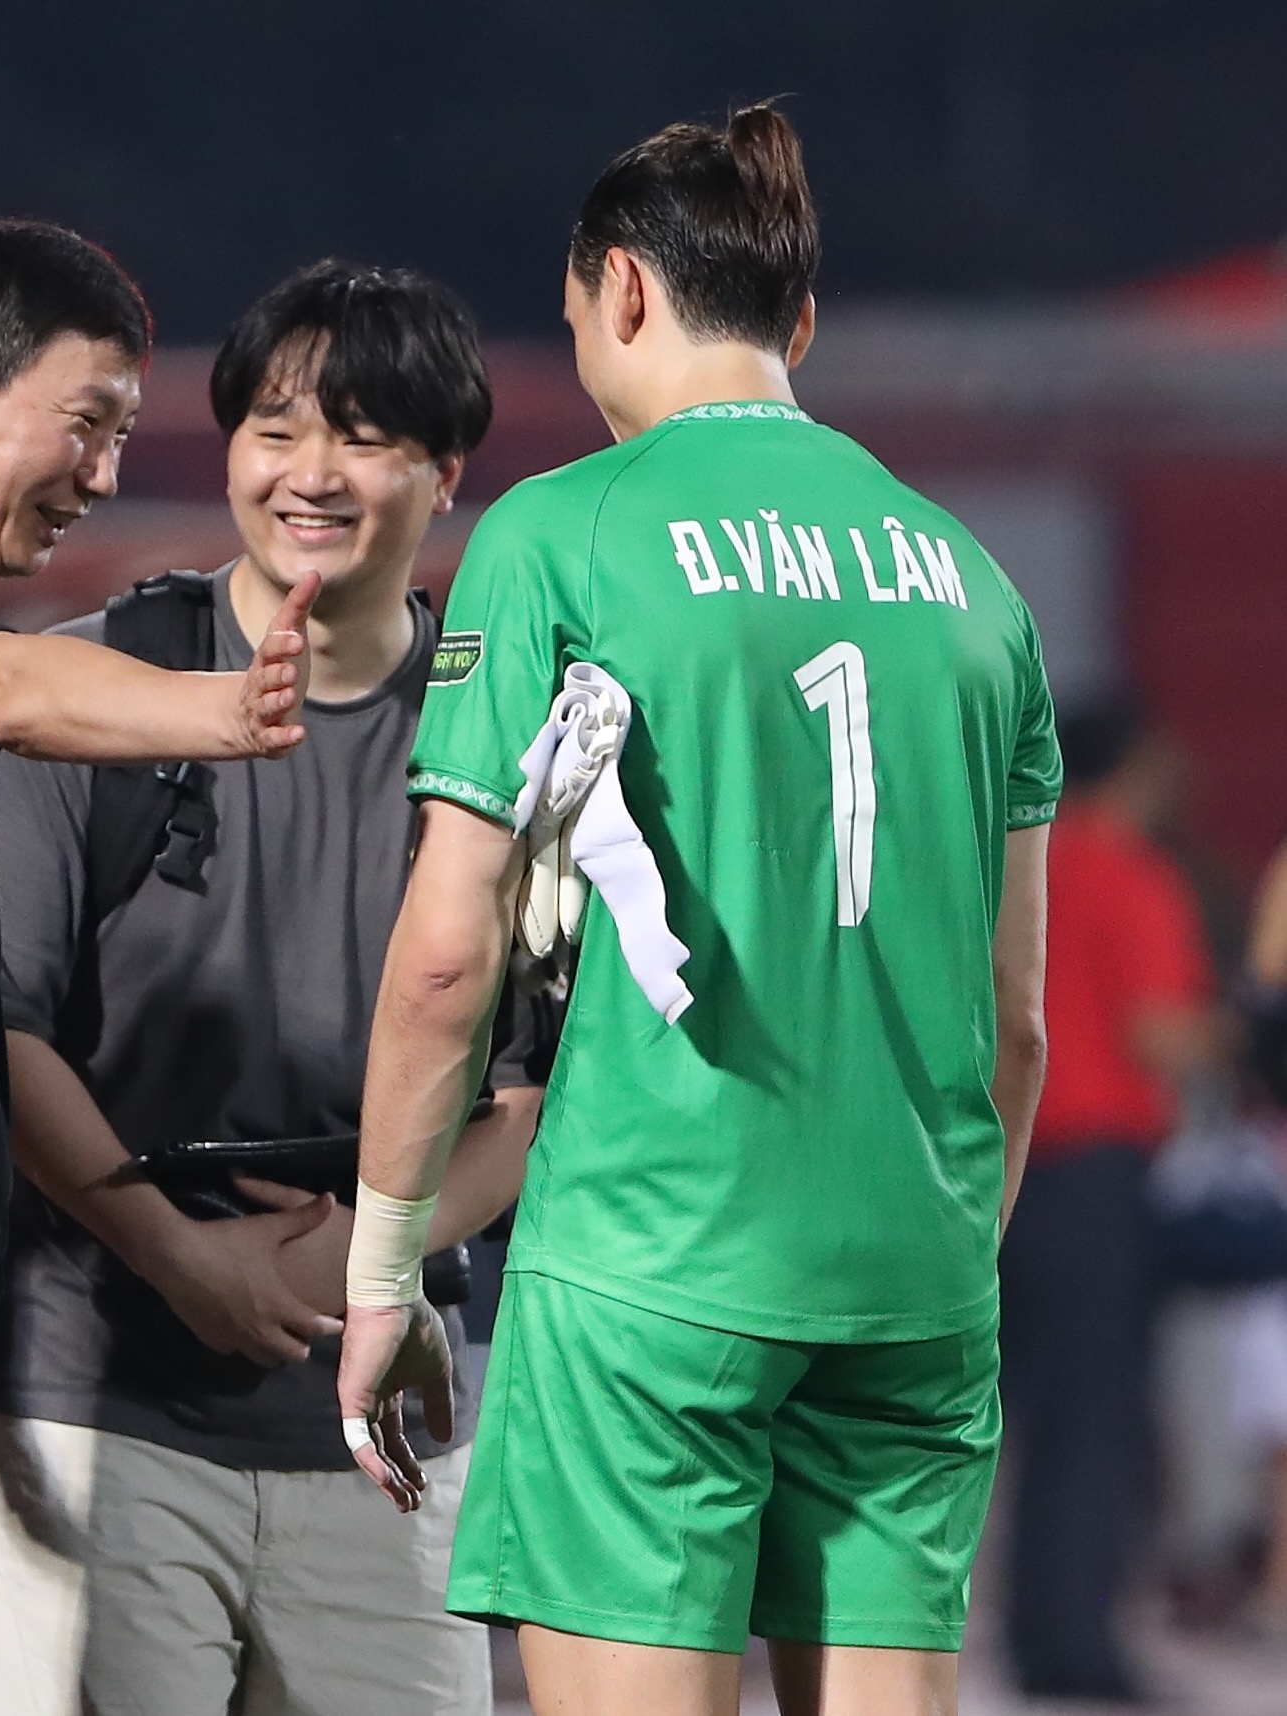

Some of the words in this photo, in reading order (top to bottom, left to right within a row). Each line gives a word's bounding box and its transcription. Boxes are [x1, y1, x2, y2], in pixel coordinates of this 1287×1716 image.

[667, 508, 841, 600] Đ.VĂN
[848, 516, 968, 610] LÂM
[793, 641, 876, 927] 1
